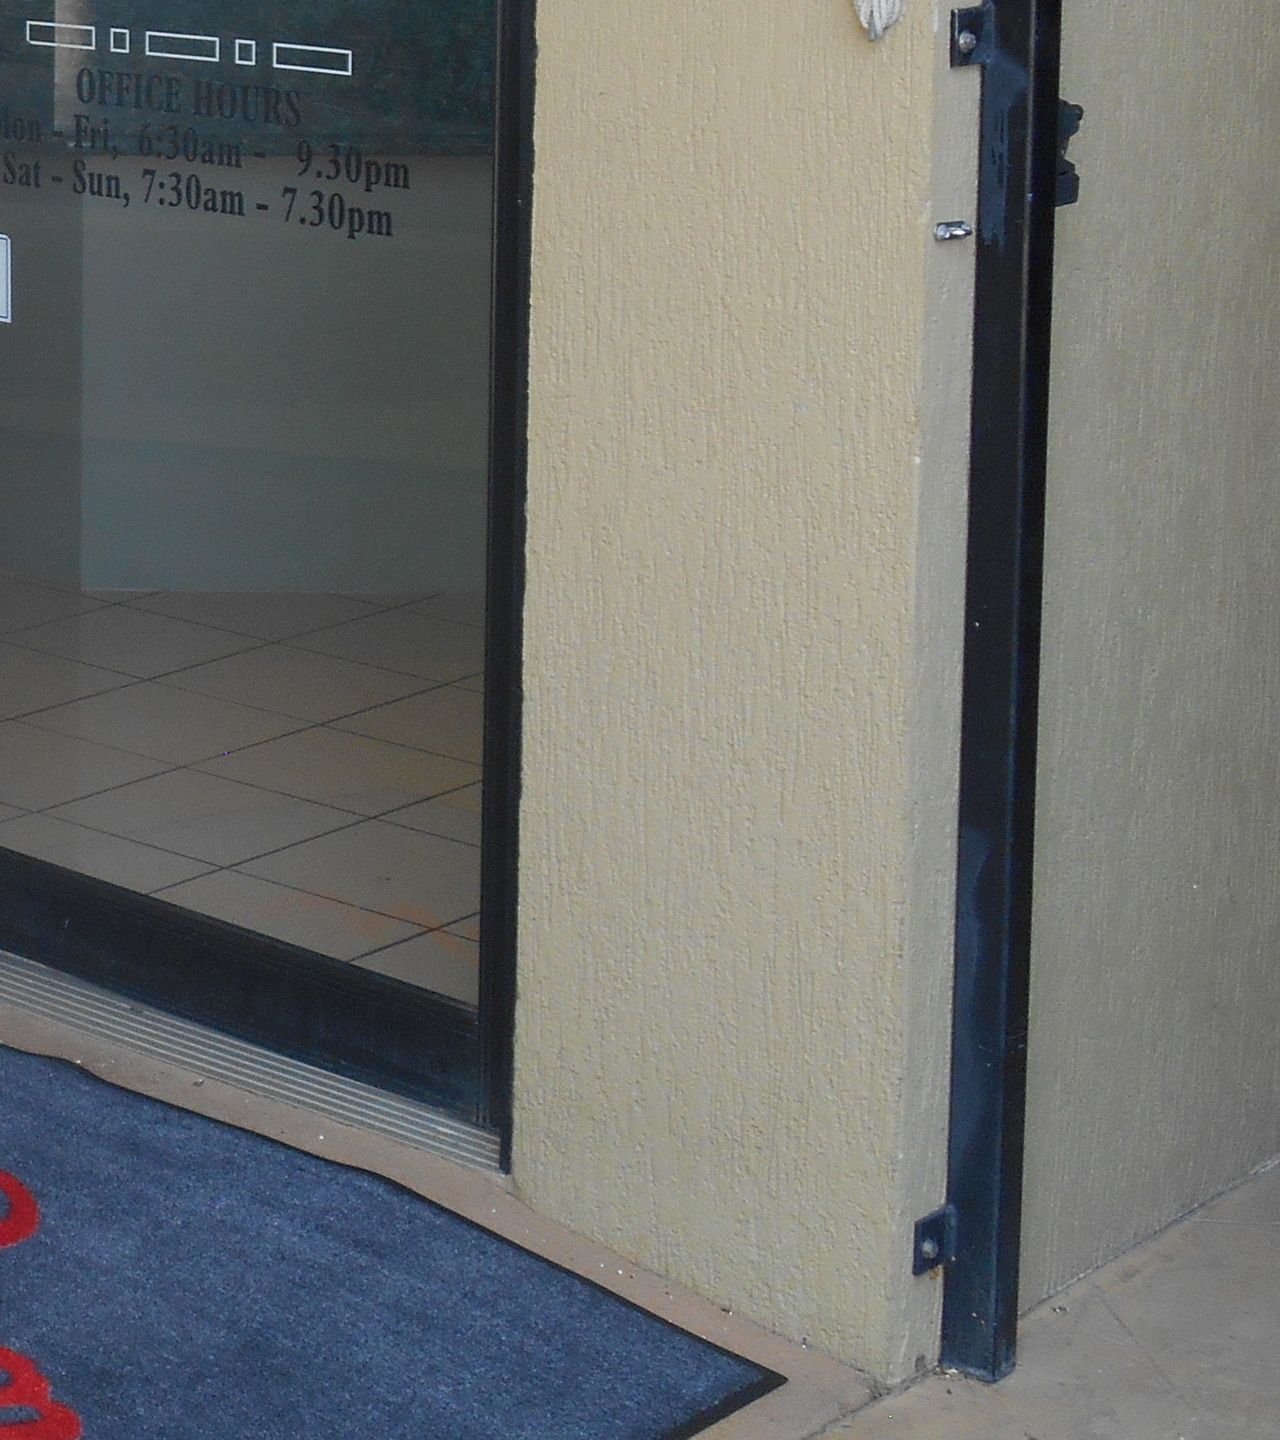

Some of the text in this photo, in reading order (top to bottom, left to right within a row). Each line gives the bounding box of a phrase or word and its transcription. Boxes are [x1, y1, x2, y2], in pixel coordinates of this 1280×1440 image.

[76, 68, 302, 128] OFFICE HOURS
[73, 113, 118, 160] Fri,
[138, 122, 243, 169] 6:30am
[296, 140, 411, 193] 9.30pm
[2, 151, 42, 189] Sat
[72, 159, 131, 208] Sun,
[141, 168, 246, 217] 7:30am
[281, 186, 393, 240] 7.30pm
